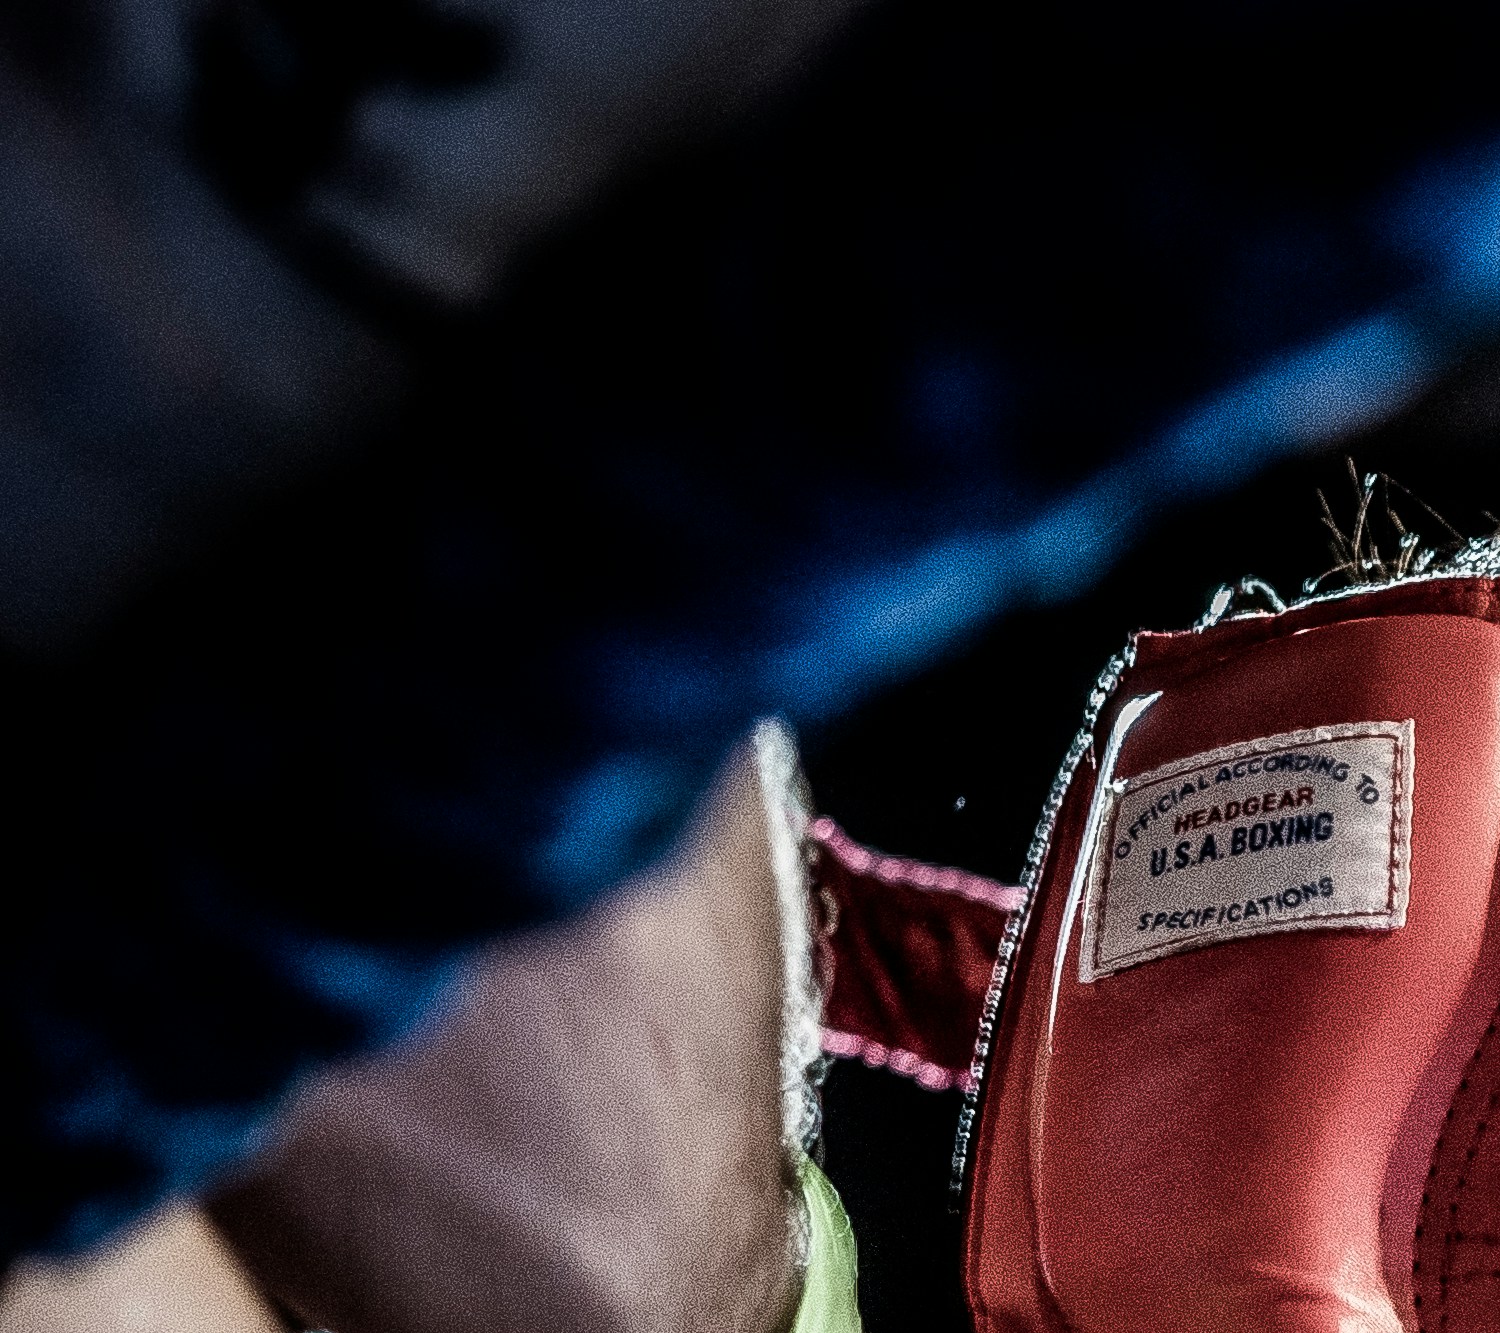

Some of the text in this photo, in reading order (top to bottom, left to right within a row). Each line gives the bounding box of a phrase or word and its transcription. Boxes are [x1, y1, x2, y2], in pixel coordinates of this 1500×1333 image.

[1114, 753, 1380, 860] OFFICIAL ACCORDING TO
[1173, 787, 1315, 835] HEADGEAR
[1150, 812, 1335, 877] U.S.A. BOXING
[1137, 876, 1334, 931] SPECIFICATIONS
